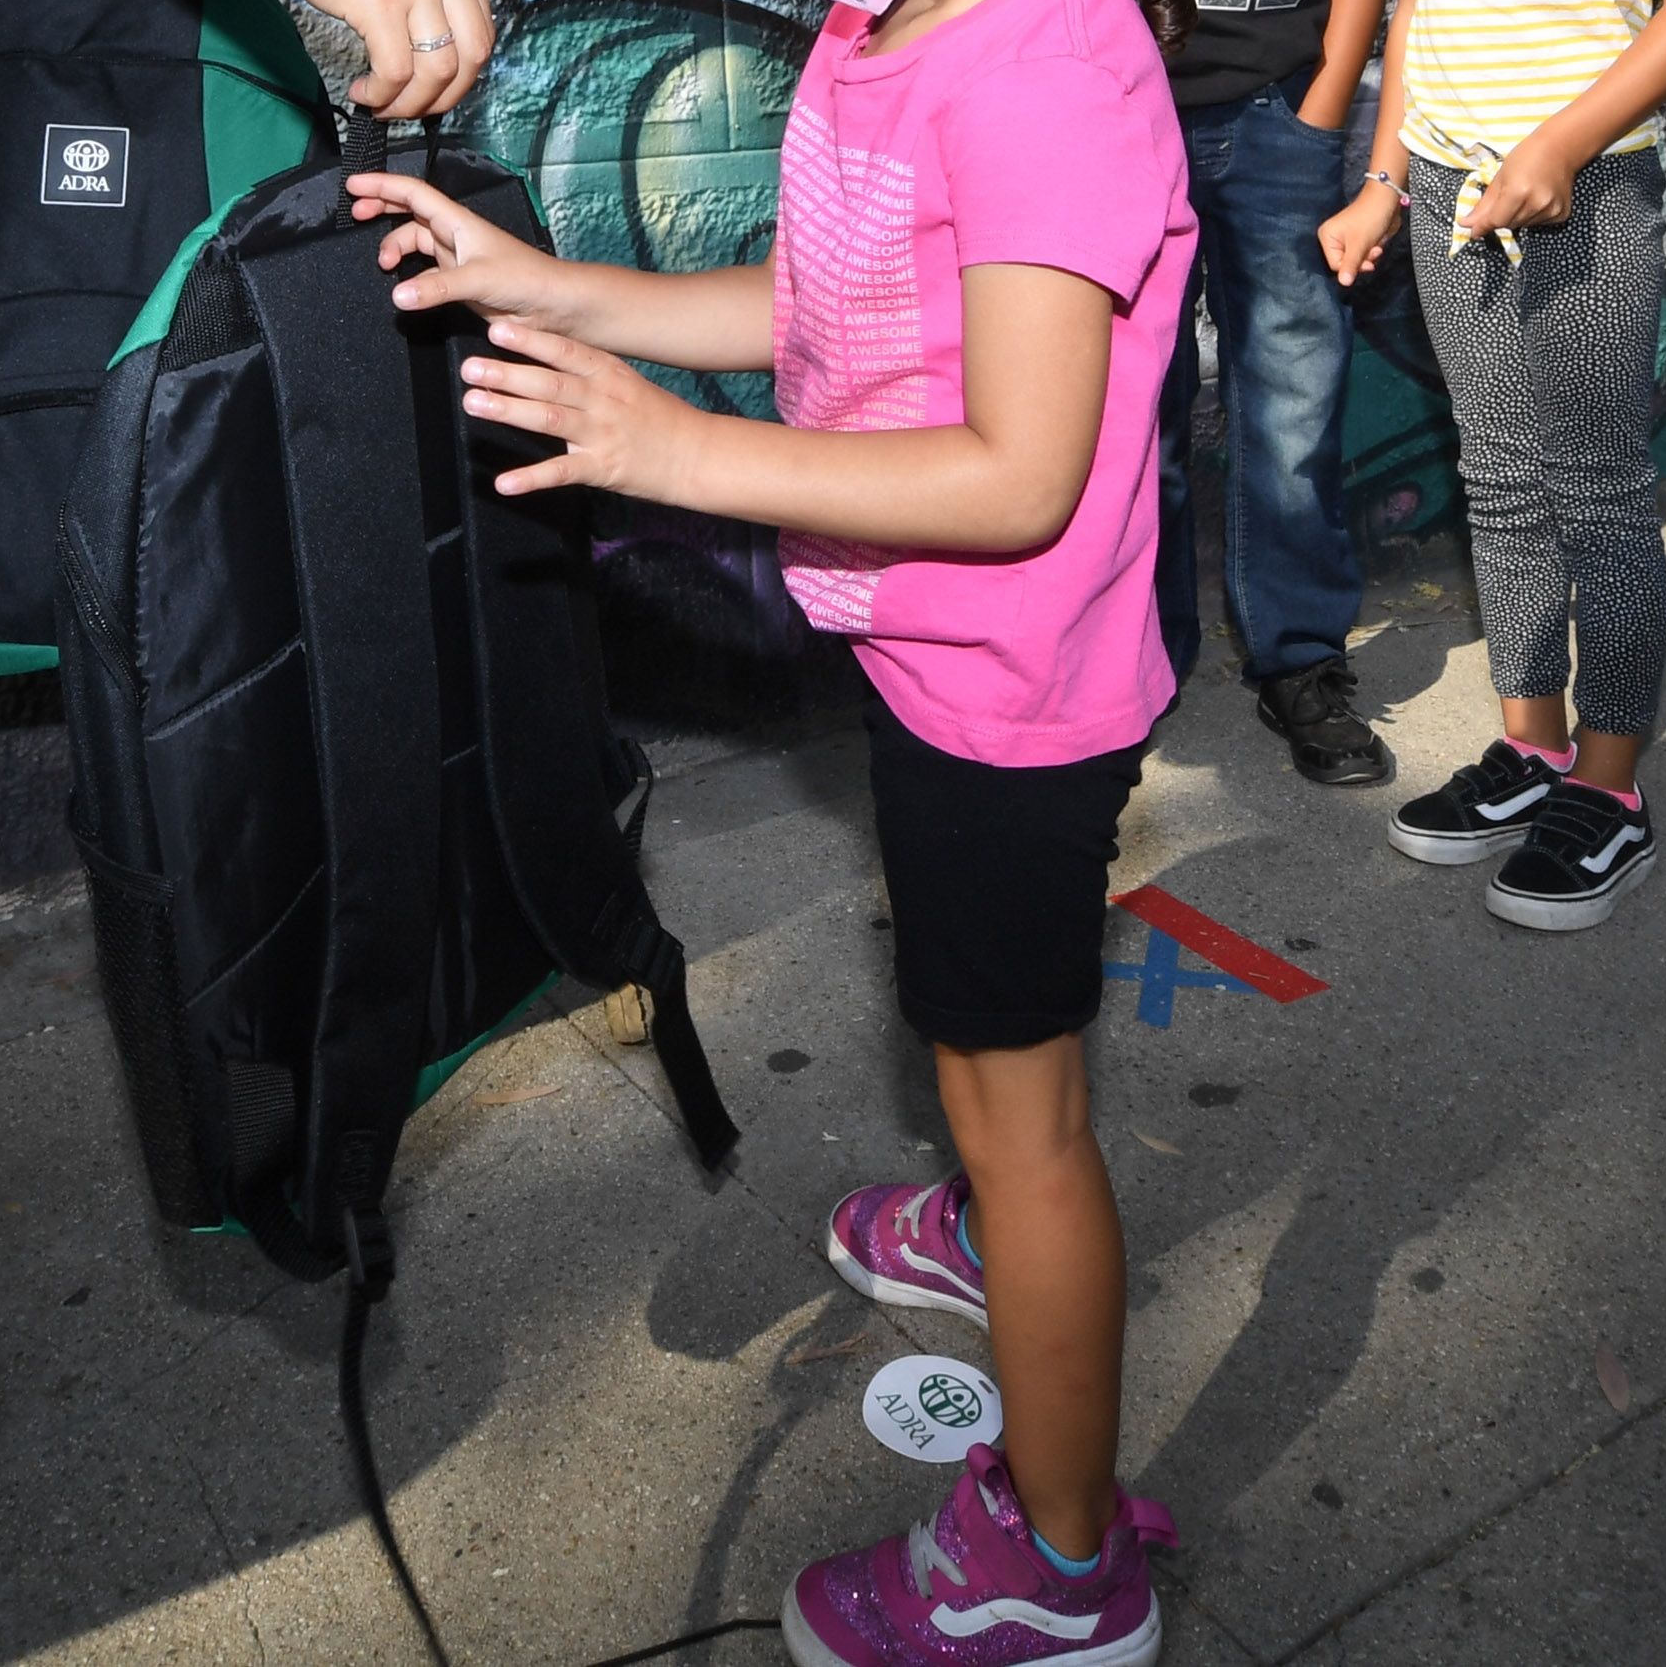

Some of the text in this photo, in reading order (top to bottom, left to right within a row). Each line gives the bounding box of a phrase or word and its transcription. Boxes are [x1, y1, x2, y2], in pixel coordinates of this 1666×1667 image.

[57, 174, 111, 192] ADRA
[846, 252, 915, 272] AWESOME
[843, 266, 918, 285] AWESOME
[841, 282, 919, 298] AWESOME
[842, 295, 920, 310] AWESOME
[843, 308, 922, 326] AWESOME
[845, 324, 922, 341] AWESOME
[847, 342, 924, 357] AWESOME
[849, 357, 926, 372] AWESOME
[861, 400, 927, 422] AWESOME
[808, 601, 872, 632] AWESOME
[874, 1393, 936, 1451] ADRA
